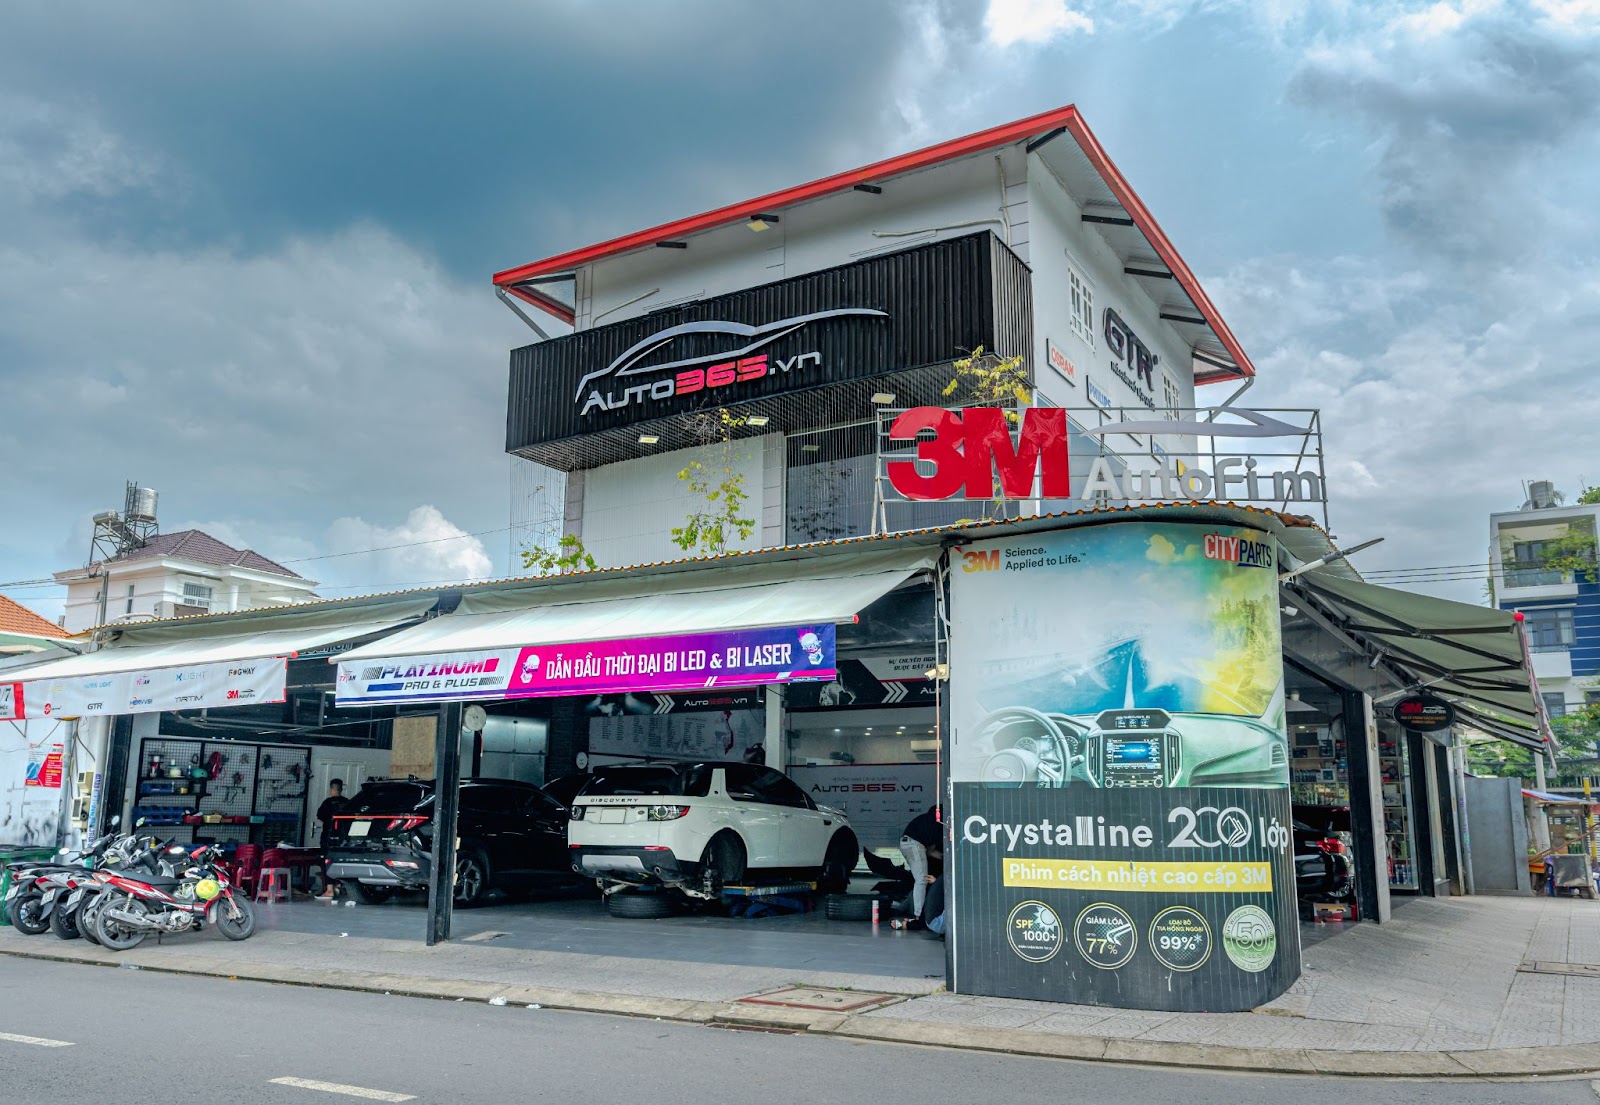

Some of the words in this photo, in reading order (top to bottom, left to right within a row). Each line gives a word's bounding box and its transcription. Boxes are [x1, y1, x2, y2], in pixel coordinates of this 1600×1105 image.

[1103, 307, 1154, 391] GTR
[1051, 347, 1074, 378] OSRAM
[887, 406, 1070, 500] 3M
[962, 549, 1000, 574] 3M
[1005, 547, 1047, 558] Science.
[1005, 557, 1044, 572] Applied
[1046, 557, 1057, 566] to
[381, 661, 486, 679] PLATINUM
[546, 653, 572, 680] DẪN
[574, 652, 601, 678] ĐẦU
[604, 652, 635, 676] THỜI
[638, 653, 661, 677] ĐẠI
[664, 652, 677, 672] BI
[681, 650, 706, 671] LED
[709, 653, 722, 669] &
[726, 647, 741, 668] BI
[745, 643, 792, 667] LASER
[404, 681, 429, 690] PRO
[432, 681, 441, 689] &
[445, 677, 479, 688] PLUS
[227, 690, 239, 700] 3M
[87, 702, 103, 710] GTR
[963, 815, 1154, 851] Crystalline
[1259, 817, 1289, 855] lớp
[1009, 862, 1053, 880] Phim
[1058, 865, 1102, 883] cách
[1107, 865, 1158, 887] nhiệt
[1163, 873, 1199, 885] cao
[1203, 865, 1237, 888] cấp
[1241, 866, 1267, 885] 3M
[1016, 919, 1033, 929] SPF
[1086, 916, 1107, 925] GIẢM
[1022, 931, 1057, 942] 1000+
[1236, 921, 1268, 952] 50
